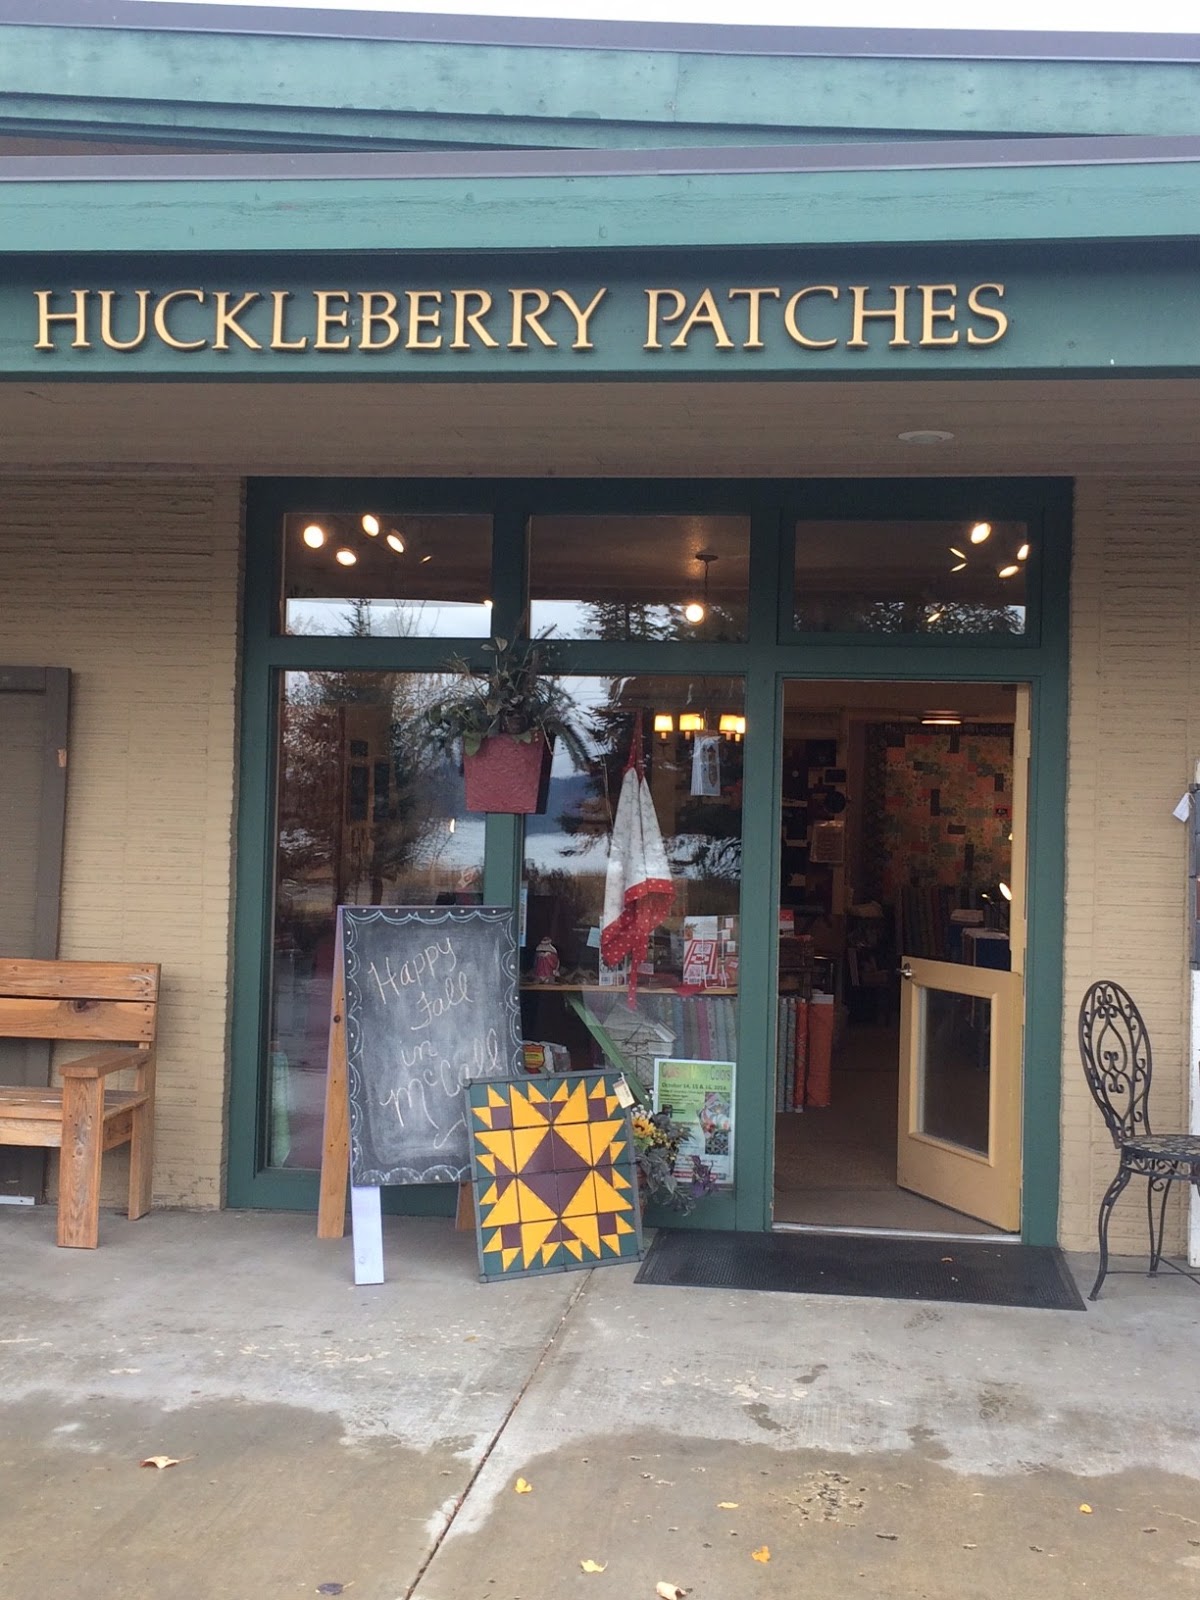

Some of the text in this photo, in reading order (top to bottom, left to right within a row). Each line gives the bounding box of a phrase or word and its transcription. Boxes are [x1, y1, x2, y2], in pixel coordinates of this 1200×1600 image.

[33, 283, 1009, 352] HUCKLEBERRY PATCHES
[367, 937, 457, 1004] Happy
[411, 971, 474, 1031] Fall
[399, 1039, 439, 1067] in
